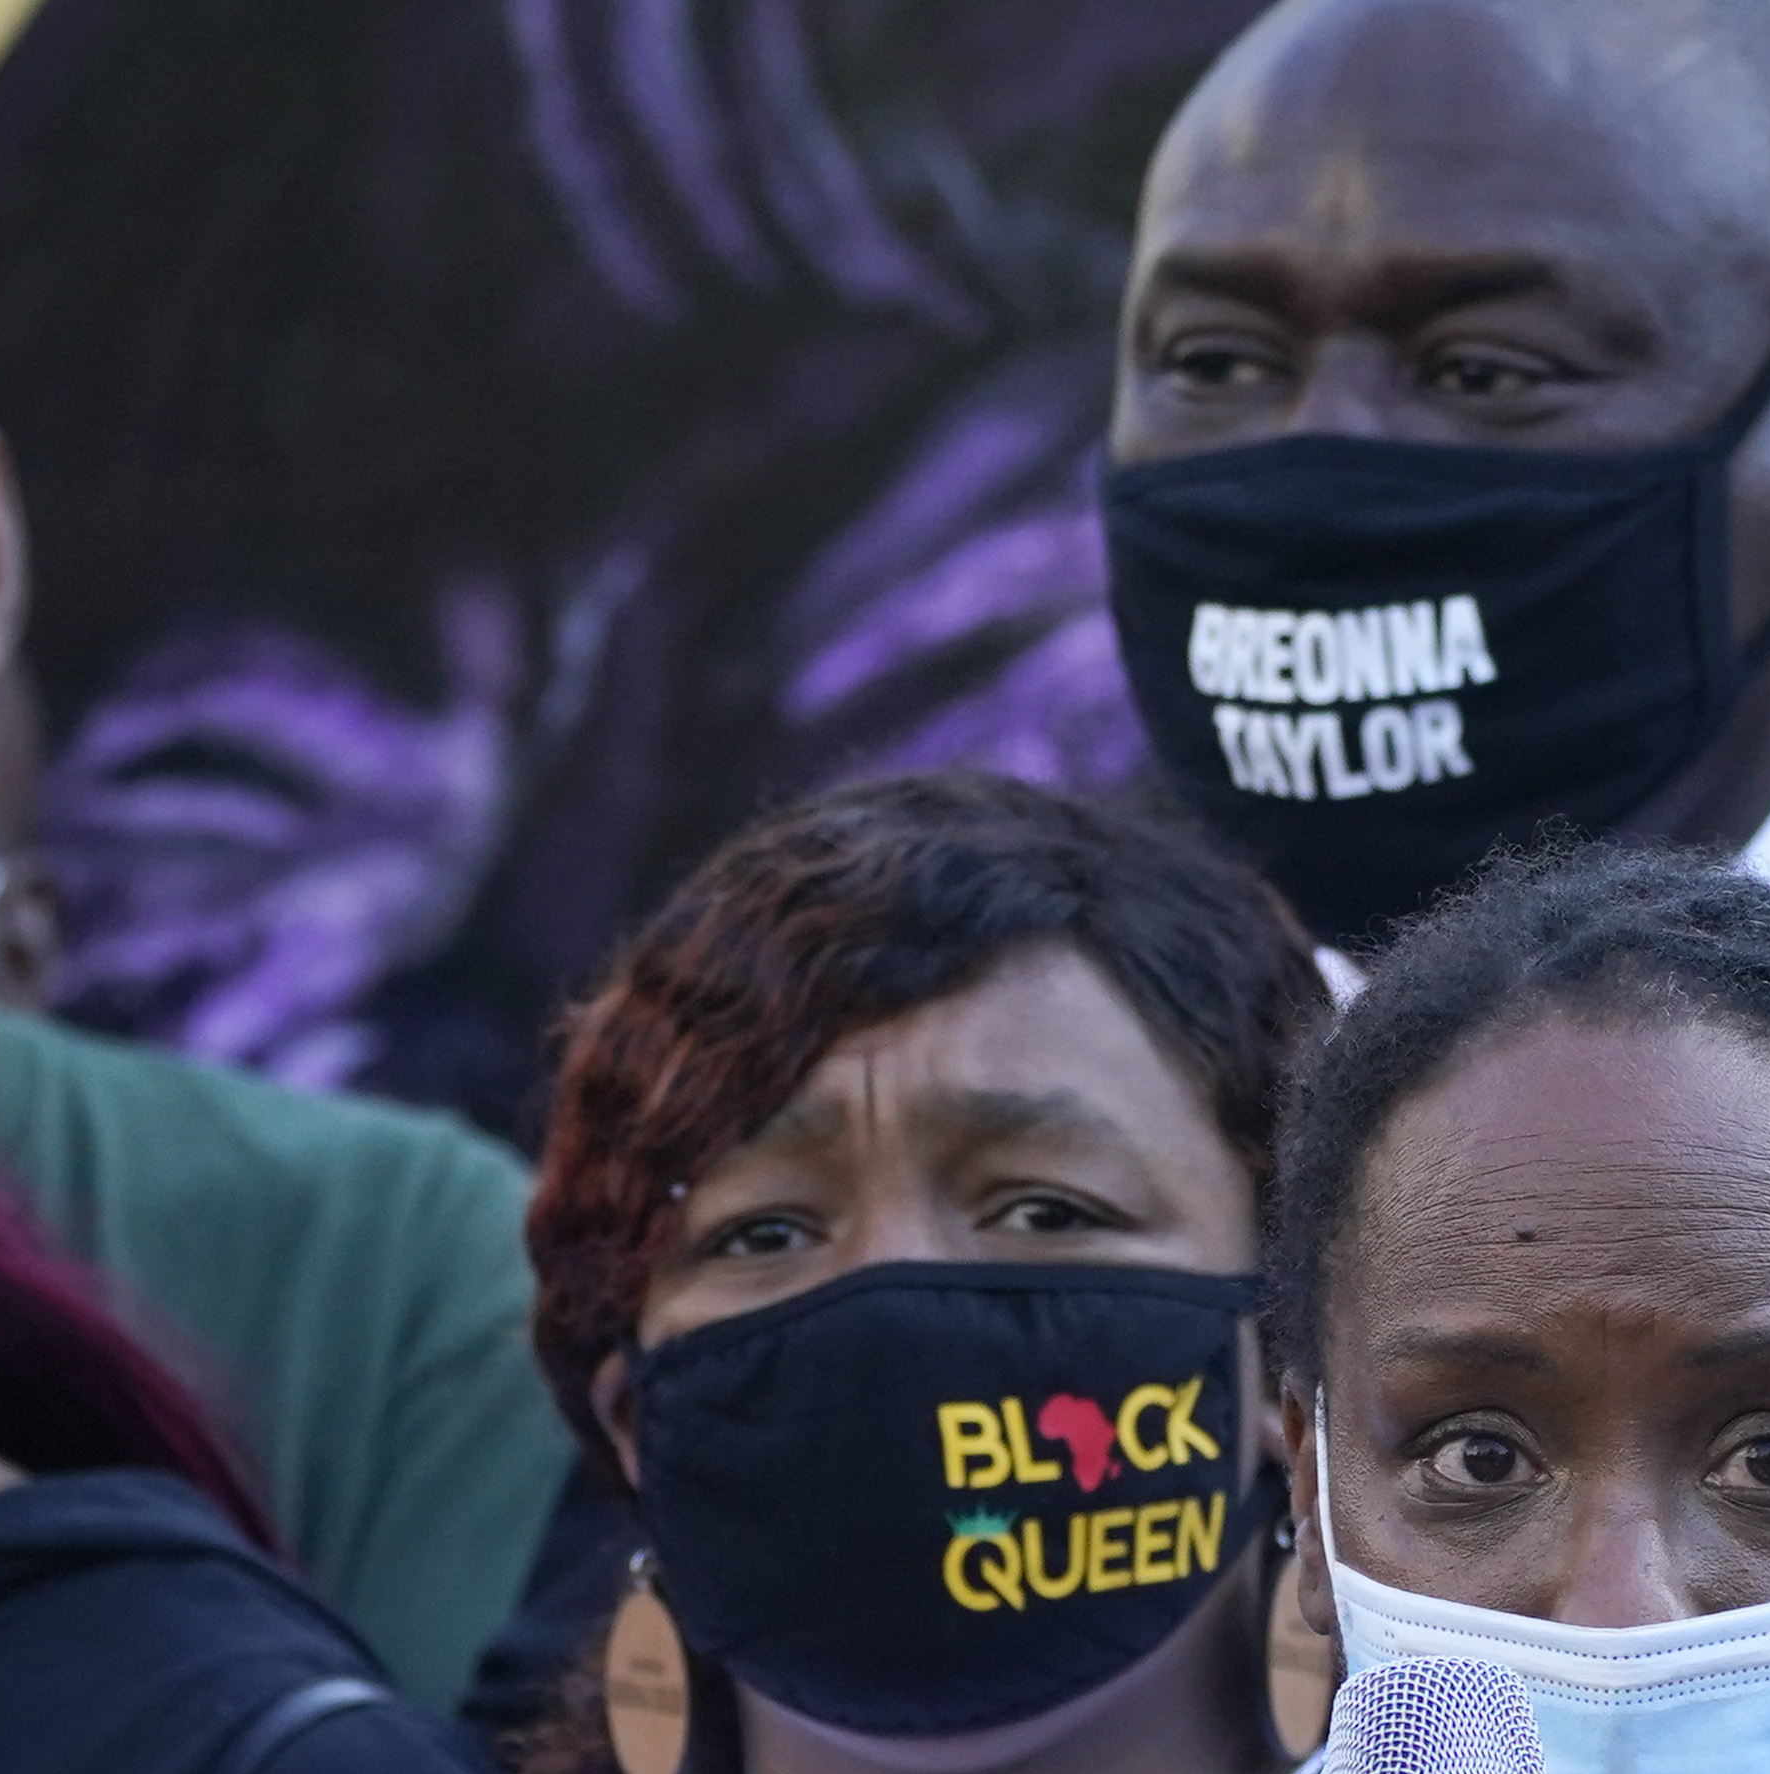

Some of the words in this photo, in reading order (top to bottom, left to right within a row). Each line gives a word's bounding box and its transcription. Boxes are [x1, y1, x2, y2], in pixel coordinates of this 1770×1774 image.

[1187, 592, 1499, 706] BREONNA
[1212, 697, 1475, 802] TAYLOR
[941, 1488, 1227, 1612] QUEEN
